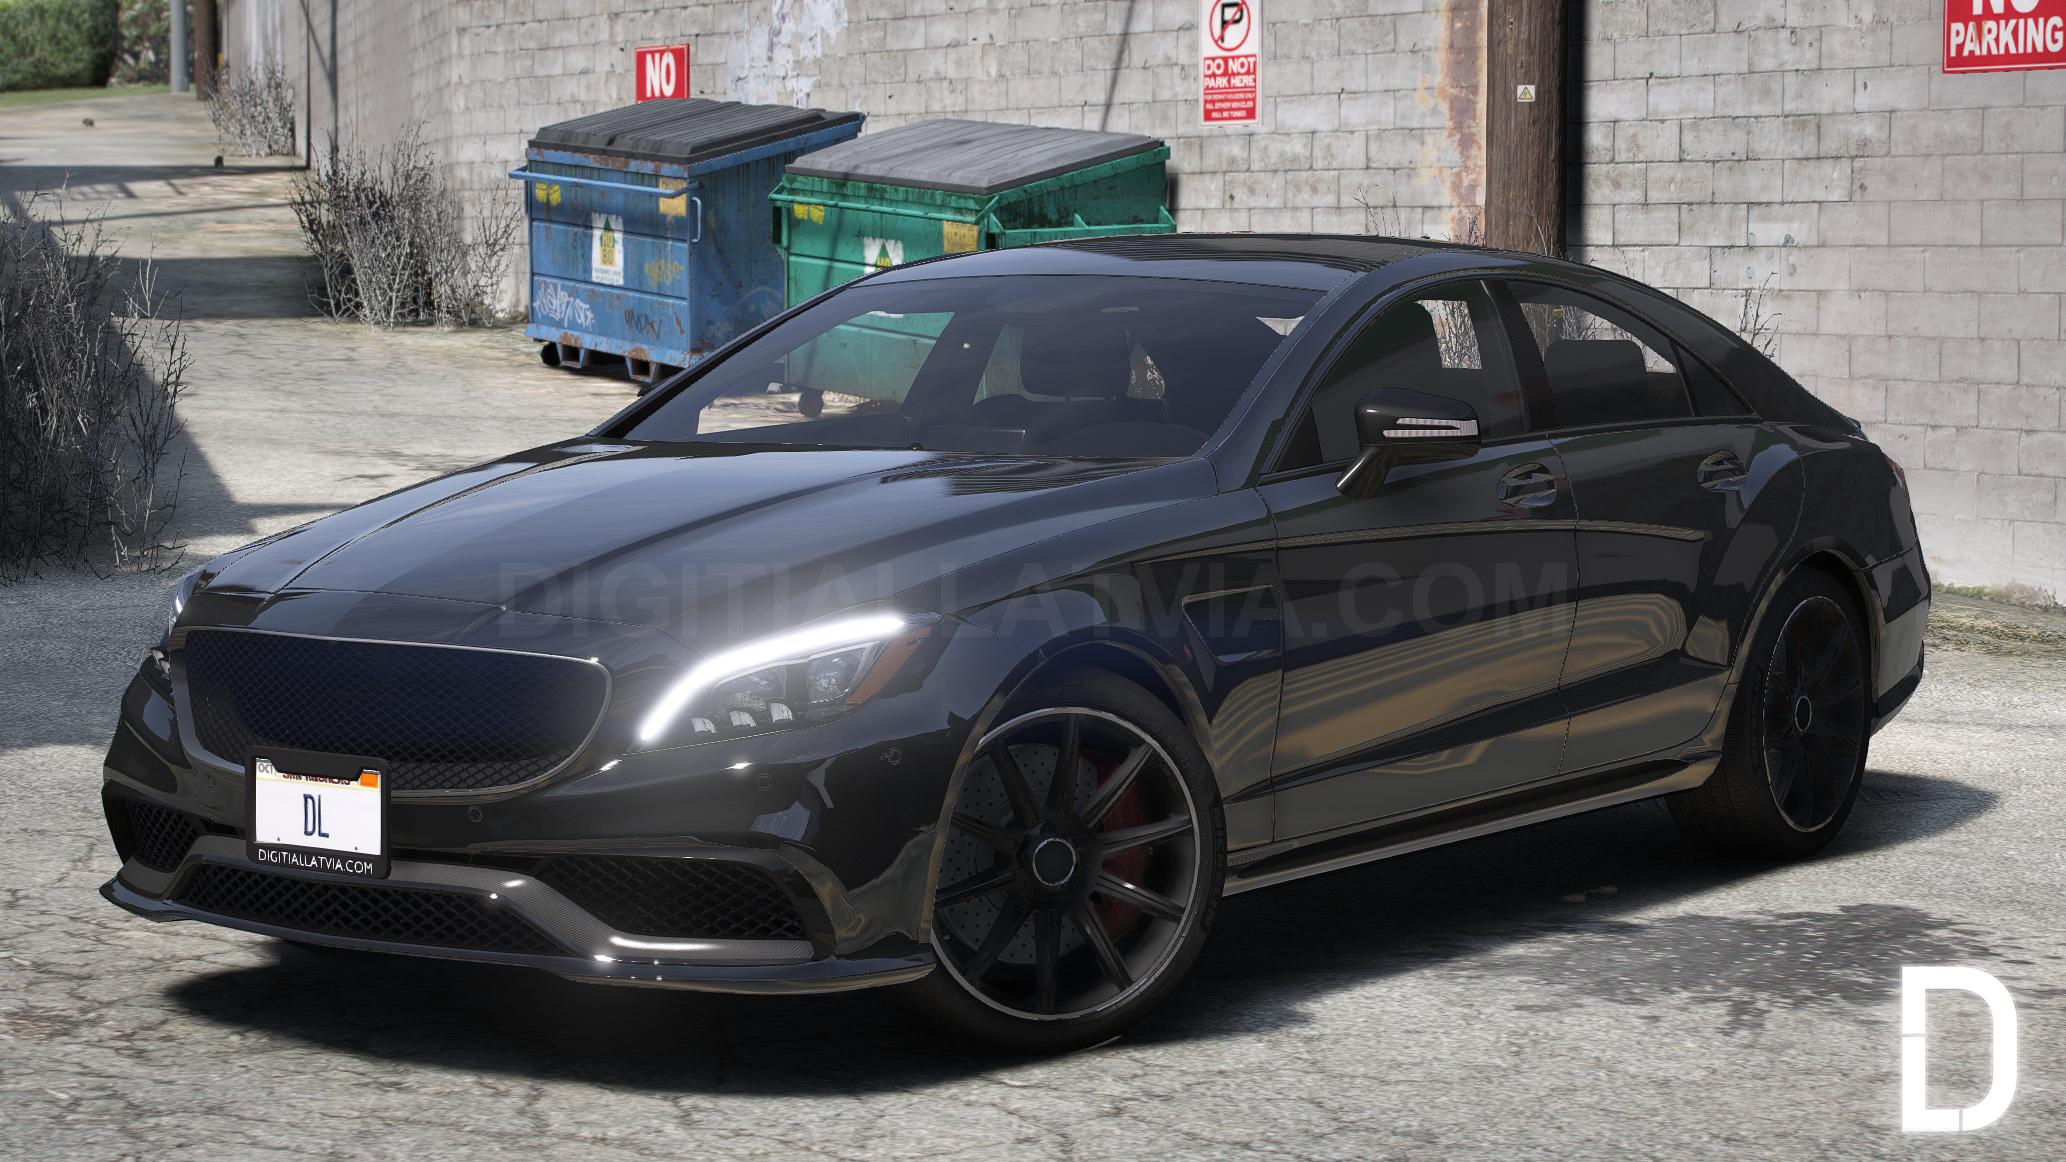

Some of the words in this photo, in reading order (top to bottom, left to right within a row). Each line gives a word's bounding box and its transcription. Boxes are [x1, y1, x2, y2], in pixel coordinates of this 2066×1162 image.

[1950, 15, 2064, 57] PARKING
[645, 50, 677, 98] NO
[1204, 59, 1224, 75] DO
[1228, 57, 1256, 74] NOT
[1204, 76, 1229, 89] PARK
[1230, 75, 1256, 88] HERE
[303, 794, 329, 838] DL
[258, 849, 373, 874] DIGITIALLATVIA.COM
